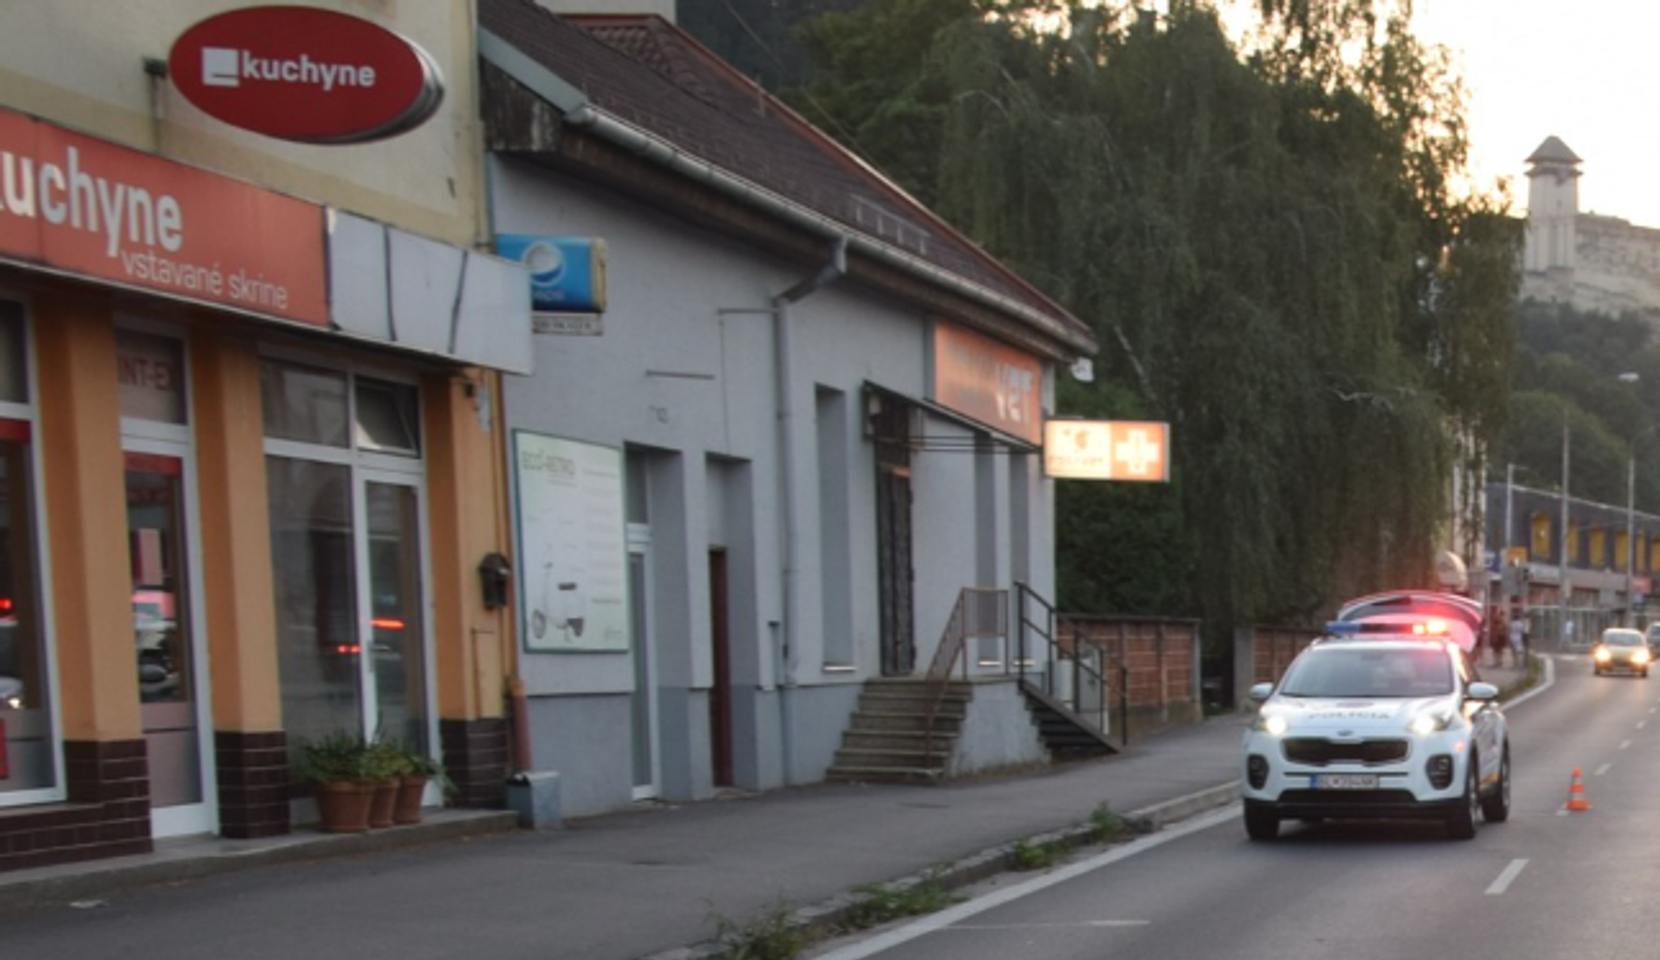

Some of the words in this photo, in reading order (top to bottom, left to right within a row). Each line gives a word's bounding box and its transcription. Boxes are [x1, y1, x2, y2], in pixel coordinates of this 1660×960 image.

[242, 50, 377, 91] kuchyne
[0, 146, 183, 258] uchyne
[121, 250, 223, 295] vstavané
[228, 268, 290, 310] skrine
